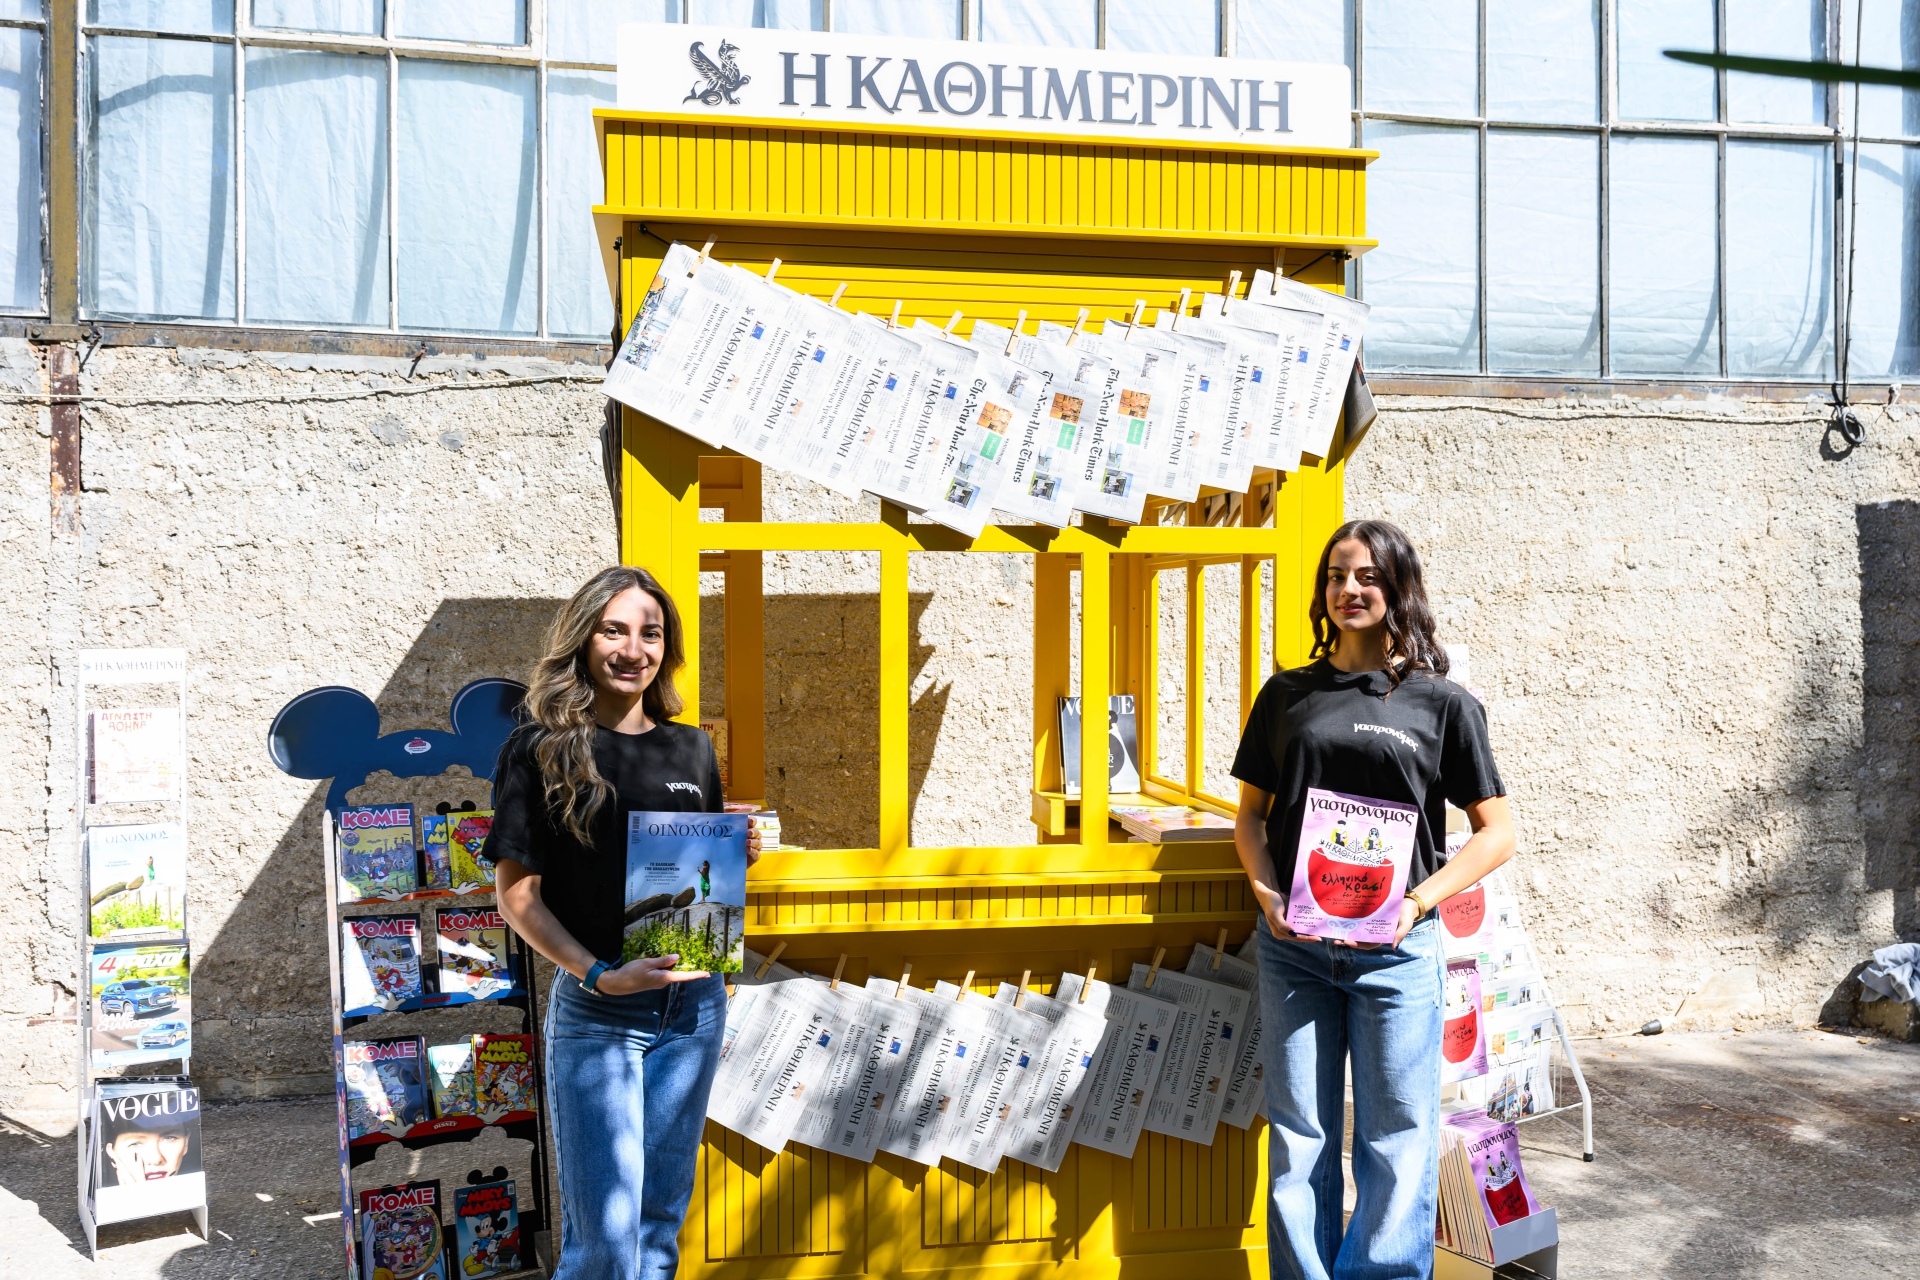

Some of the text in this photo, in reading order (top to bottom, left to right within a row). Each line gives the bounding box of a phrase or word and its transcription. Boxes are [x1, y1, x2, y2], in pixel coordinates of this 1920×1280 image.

[780, 52, 1293, 133] Η ΚΑΘΗΜΕΡΙΝΗ
[698, 326, 745, 405] ΚΑΘΗΜΕΡΙΝΗ
[1305, 342, 1334, 420] ΚΑΘΗΜΕΡΙΝΗ
[762, 350, 807, 430] ΚΑΘΗΜΕΡΙΝΗ
[967, 376, 988, 401] The
[1269, 356, 1291, 436] ΚΑΘΗΜΕΡΙΝΗ
[836, 377, 879, 458] ΚΑΘΗΜΕΡΙΝΗ
[957, 398, 978, 425] New
[1083, 367, 1120, 482] The New York Times
[1168, 385, 1192, 465] ΚΑΘΗΜΕΡΙΝΗ
[1220, 376, 1245, 456] ΚΑΘΗΜΕΡΙΝΗ
[903, 389, 939, 470] ΚΑΘΗΜΕΡΙΝΗ
[1021, 418, 1041, 449] York
[1011, 447, 1033, 484] Times
[101, 711, 153, 721] ΑΓΝΩΣΤΗ
[1353, 722, 1419, 752] γαστρονόμος
[1309, 796, 1415, 827] γαστρονόμος
[1321, 871, 1368, 885] ελληνικό
[1345, 876, 1386, 893] κρασί
[96, 1018, 160, 1031] CHANGERS
[98, 1011, 135, 1022] GAME
[804, 1023, 818, 1035] Η
[1206, 1019, 1218, 1029] Η
[875, 1033, 887, 1044] Η
[1133, 1031, 1144, 1042] Η
[1169, 1035, 1182, 1060] Κέντρα
[764, 1033, 812, 1112] ΚΑΘΗΜΕΡΙΝΗ
[848, 1044, 883, 1125] ΚΑΘΗΜΕΡΙΝΗ
[914, 1037, 952, 1128] Η ΚΑΘΗΜΕΡΙΝΗ
[1109, 1042, 1142, 1121] ΚΑΘΗΜΕΡΙΝΗ
[1163, 1060, 1176, 1083] Υγείας
[1169, 1070, 1181, 1094] γιατροί
[1186, 1030, 1215, 1108] ΚΑΘΗΜΕΡΙΝΗ
[102, 1088, 198, 1122] VOGUE
[974, 1046, 1016, 1134] Η ΚΑΘΗΜΕΡΙΝΗ
[1037, 1047, 1078, 1135] Η ΚΑΘΗΜΕΡΙΝΗ
[433, 1120, 458, 1130] DISNEY
